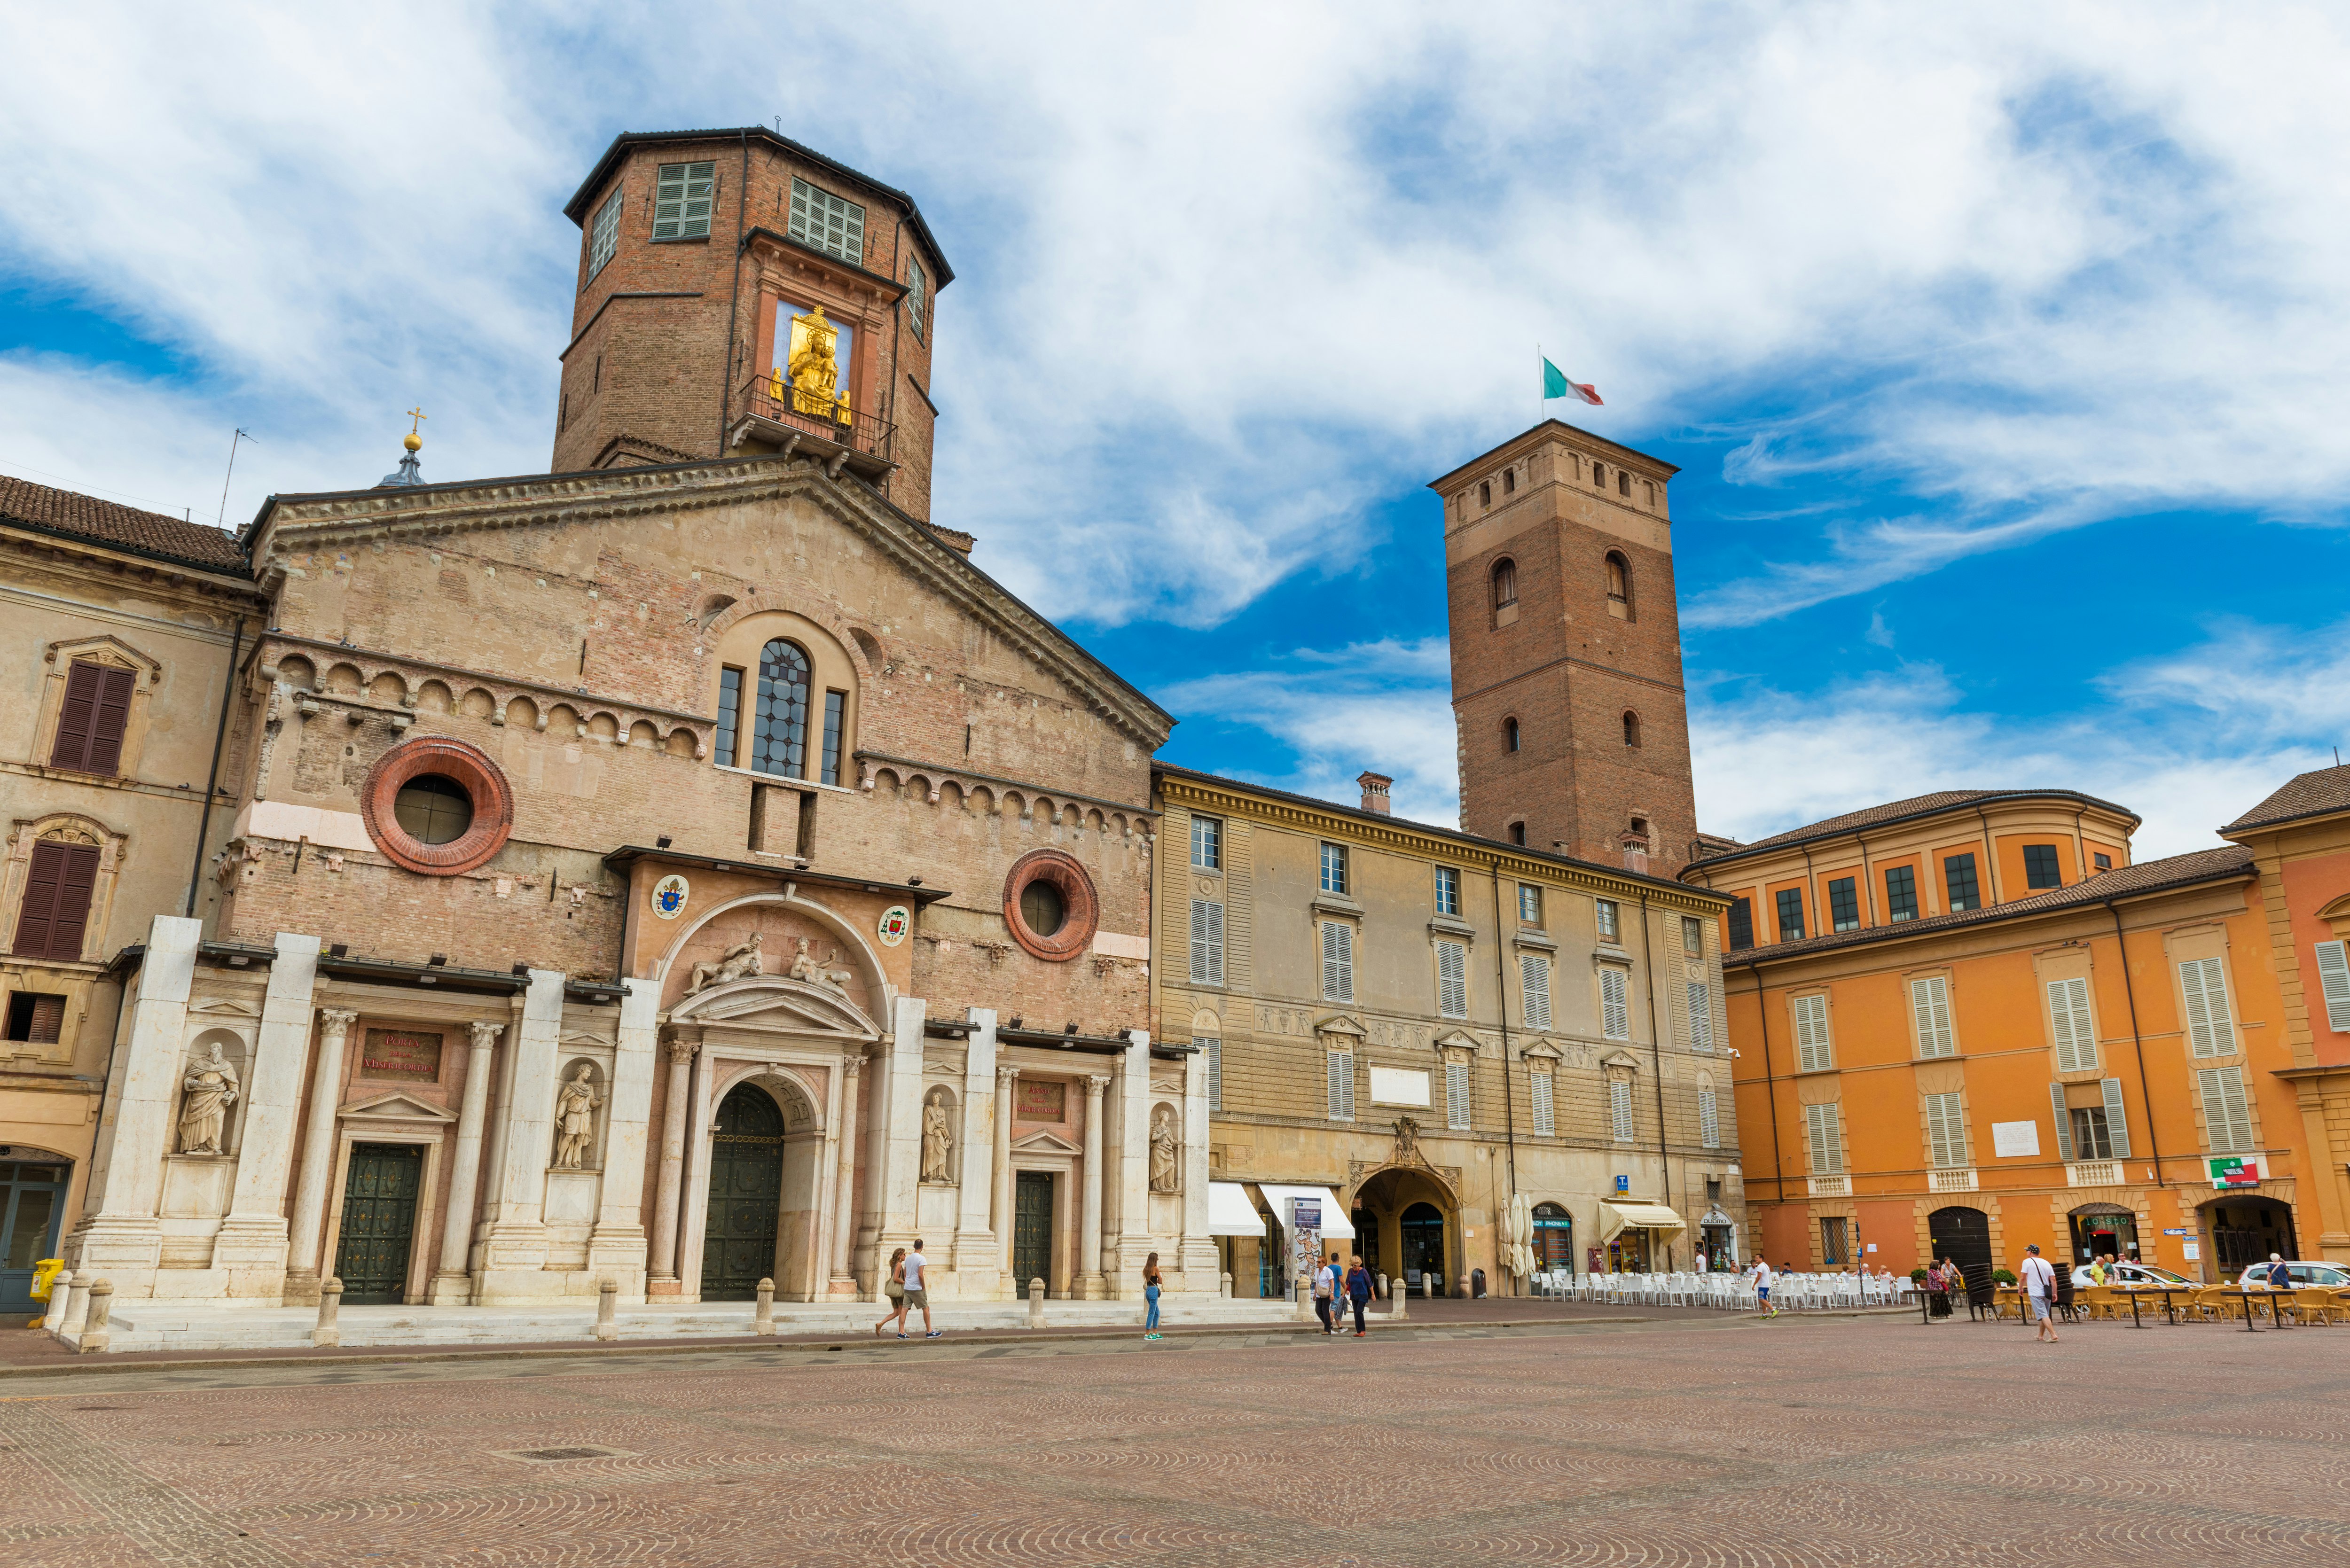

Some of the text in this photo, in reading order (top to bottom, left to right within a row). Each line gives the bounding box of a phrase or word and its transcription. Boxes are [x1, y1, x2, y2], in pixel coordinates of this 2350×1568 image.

[385, 1035, 419, 1047] PORTA
[363, 1058, 434, 1072] MISERICORDIA
[1018, 1104, 1060, 1114] MISERICORDIA
[1619, 1177, 1625, 1185] T
